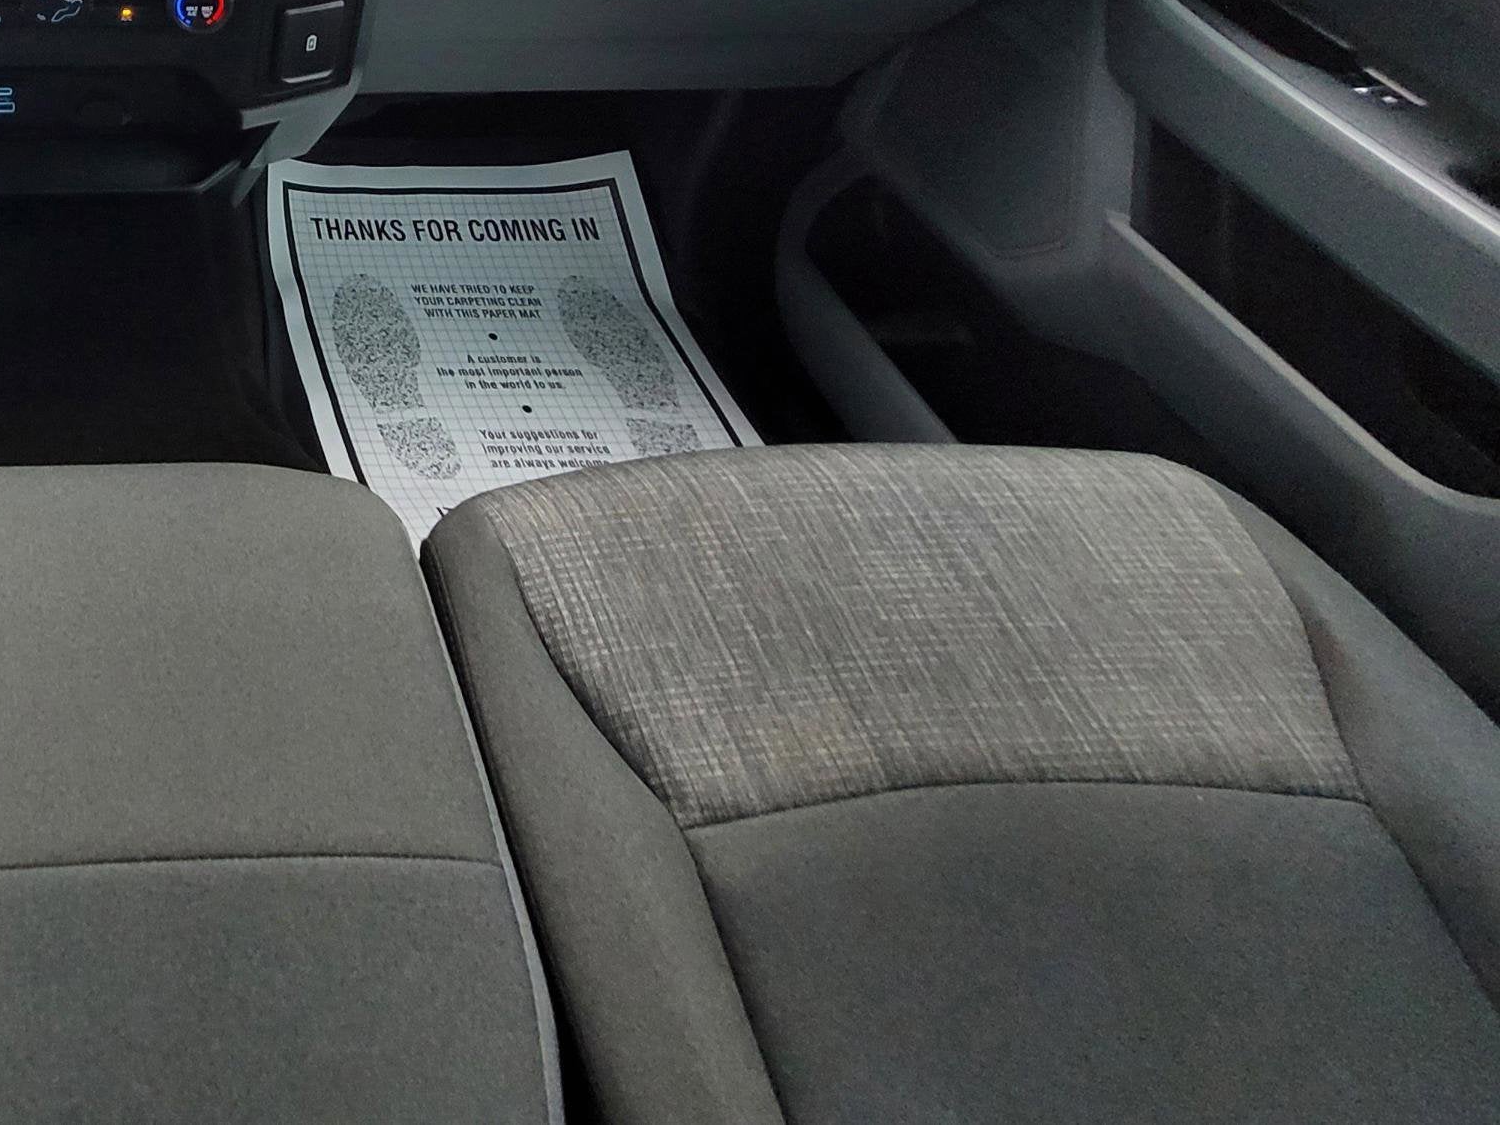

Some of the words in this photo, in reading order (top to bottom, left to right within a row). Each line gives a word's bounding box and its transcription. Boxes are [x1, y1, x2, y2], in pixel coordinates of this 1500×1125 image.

[310, 217, 406, 242] THANKS
[414, 219, 463, 242] FOR
[468, 218, 566, 243] COMING
[572, 217, 600, 241] IN
[411, 284, 428, 293] WE
[429, 284, 458, 294] HAVE
[459, 284, 491, 294] TRIED
[492, 284, 507, 294] TO
[509, 285, 535, 295] KEEP
[414, 296, 445, 306] YOUR
[446, 296, 506, 306] CARPETING
[507, 297, 542, 306] CLEAN
[424, 308, 452, 318] WITH
[454, 308, 480, 318] THIS
[481, 309, 518, 319] PAPER
[518, 309, 541, 319] MAT
[467, 354, 476, 364] A
[477, 355, 528, 364] customer
[530, 355, 542, 364] is
[436, 367, 455, 377] the
[458, 367, 485, 376] most
[488, 367, 542, 378] important
[544, 368, 583, 378] person
[465, 380, 477, 389] in
[478, 379, 498, 389] the
[500, 379, 532, 390] world
[533, 380, 546, 389] to
[479, 429, 507, 440] Your
[509, 430, 580, 442] suggestions
[581, 430, 599, 440] for
[481, 442, 543, 455] improving
[545, 444, 564, 454] our
[566, 443, 611, 454] service
[491, 459, 511, 468] are
[514, 458, 556, 470] always
